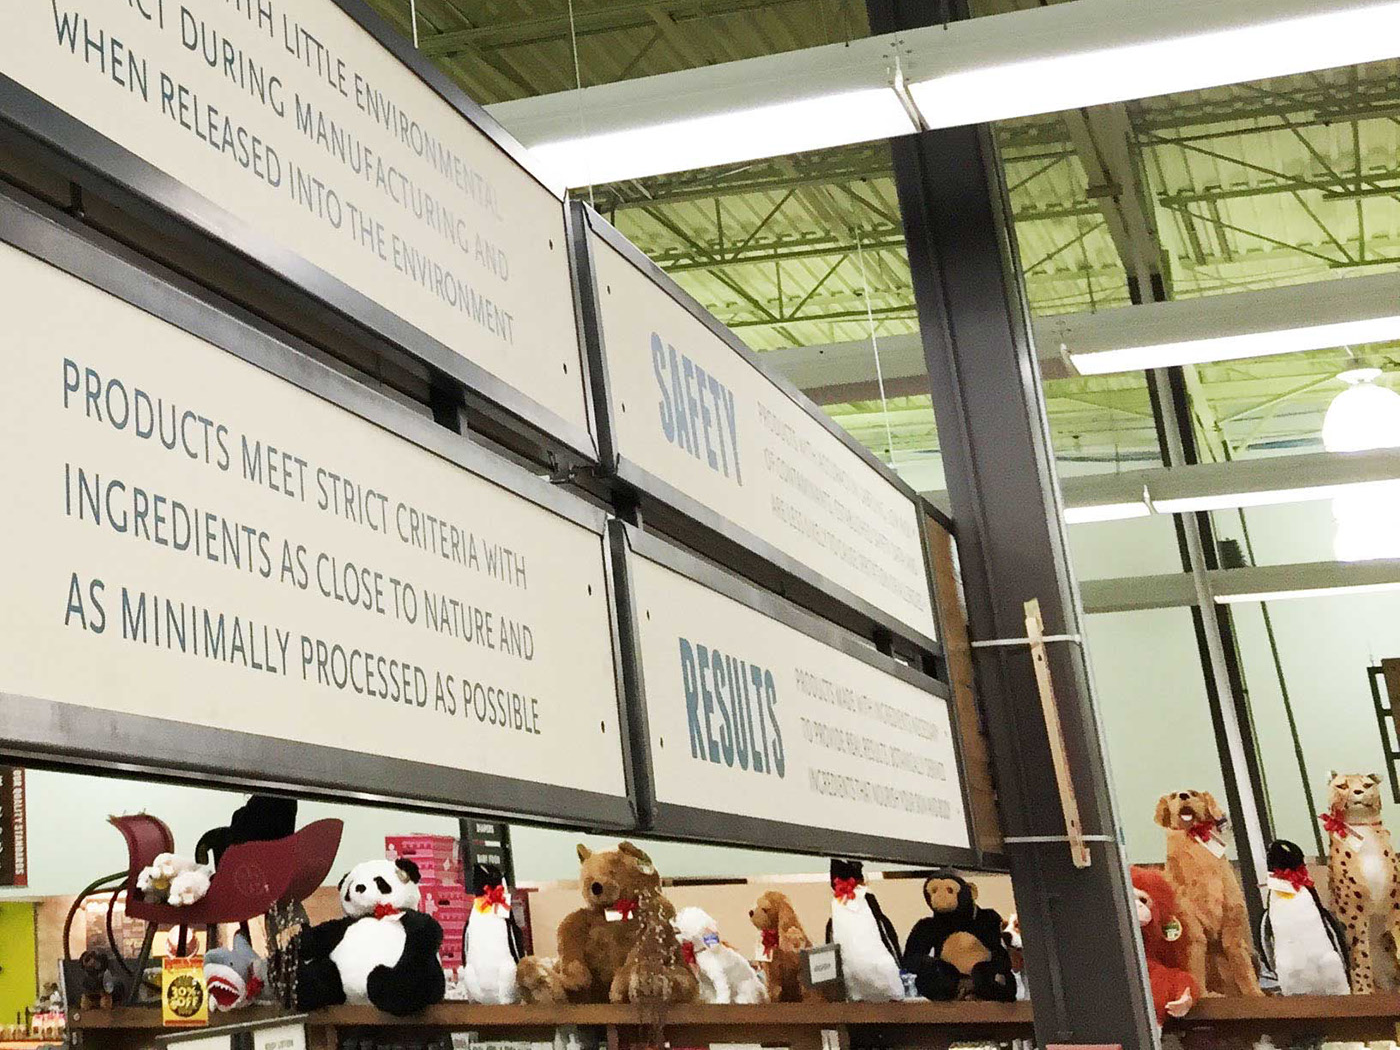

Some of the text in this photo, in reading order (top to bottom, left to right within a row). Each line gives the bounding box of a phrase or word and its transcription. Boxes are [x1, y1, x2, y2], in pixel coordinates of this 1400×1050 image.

[160, 71, 281, 187] RELEASED
[289, 162, 342, 230] INTO
[346, 201, 387, 262] THE
[393, 231, 514, 346] ENVIRONMENT
[181, 6, 285, 117] DURING
[295, 93, 469, 254] MANUFACTURING
[475, 234, 509, 281] AND
[283, 14, 348, 97] LITTLE
[354, 72, 504, 222] ENVIRONMENTAL
[63, 357, 528, 590] PRODUCTS MEET STRICT CRITERIA WITH
[650, 331, 743, 487] SAFETY
[64, 462, 535, 662] INGREDIENTS AS CLOSE TO NATURE AND
[64, 572, 542, 736] AS MINIMALLY PROCESSED AS POSSIBLE
[678, 636, 785, 779] RESULTS
[13, 787, 23, 823] QUALITY
[14, 823, 25, 875] STANDARDS
